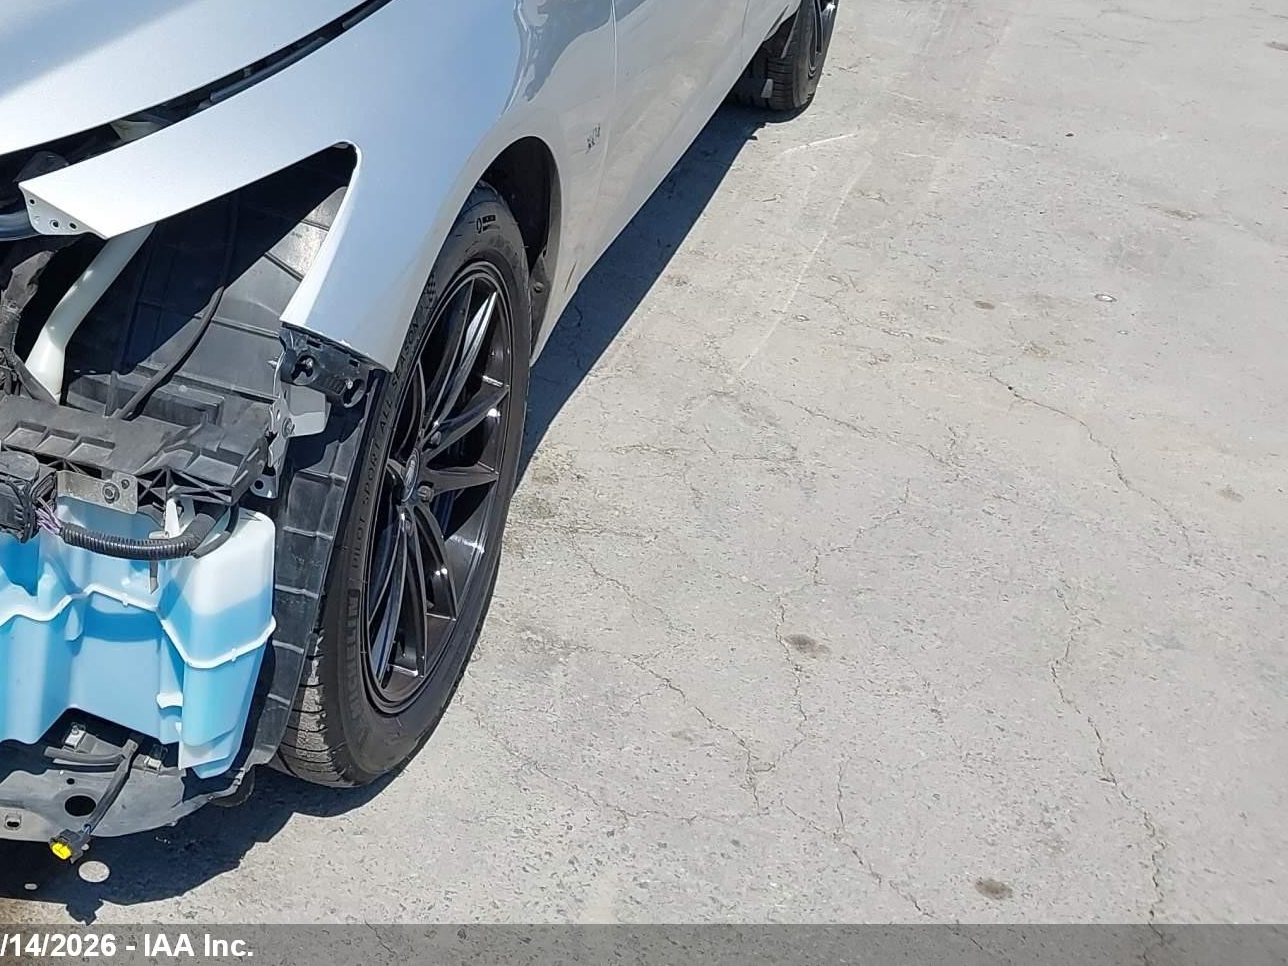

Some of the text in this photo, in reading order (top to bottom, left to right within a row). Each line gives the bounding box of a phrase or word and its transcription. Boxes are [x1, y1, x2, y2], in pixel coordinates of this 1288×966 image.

[351, 518, 366, 570] PILOT
[362, 441, 381, 507] SPORT
[379, 400, 394, 434] ALL
